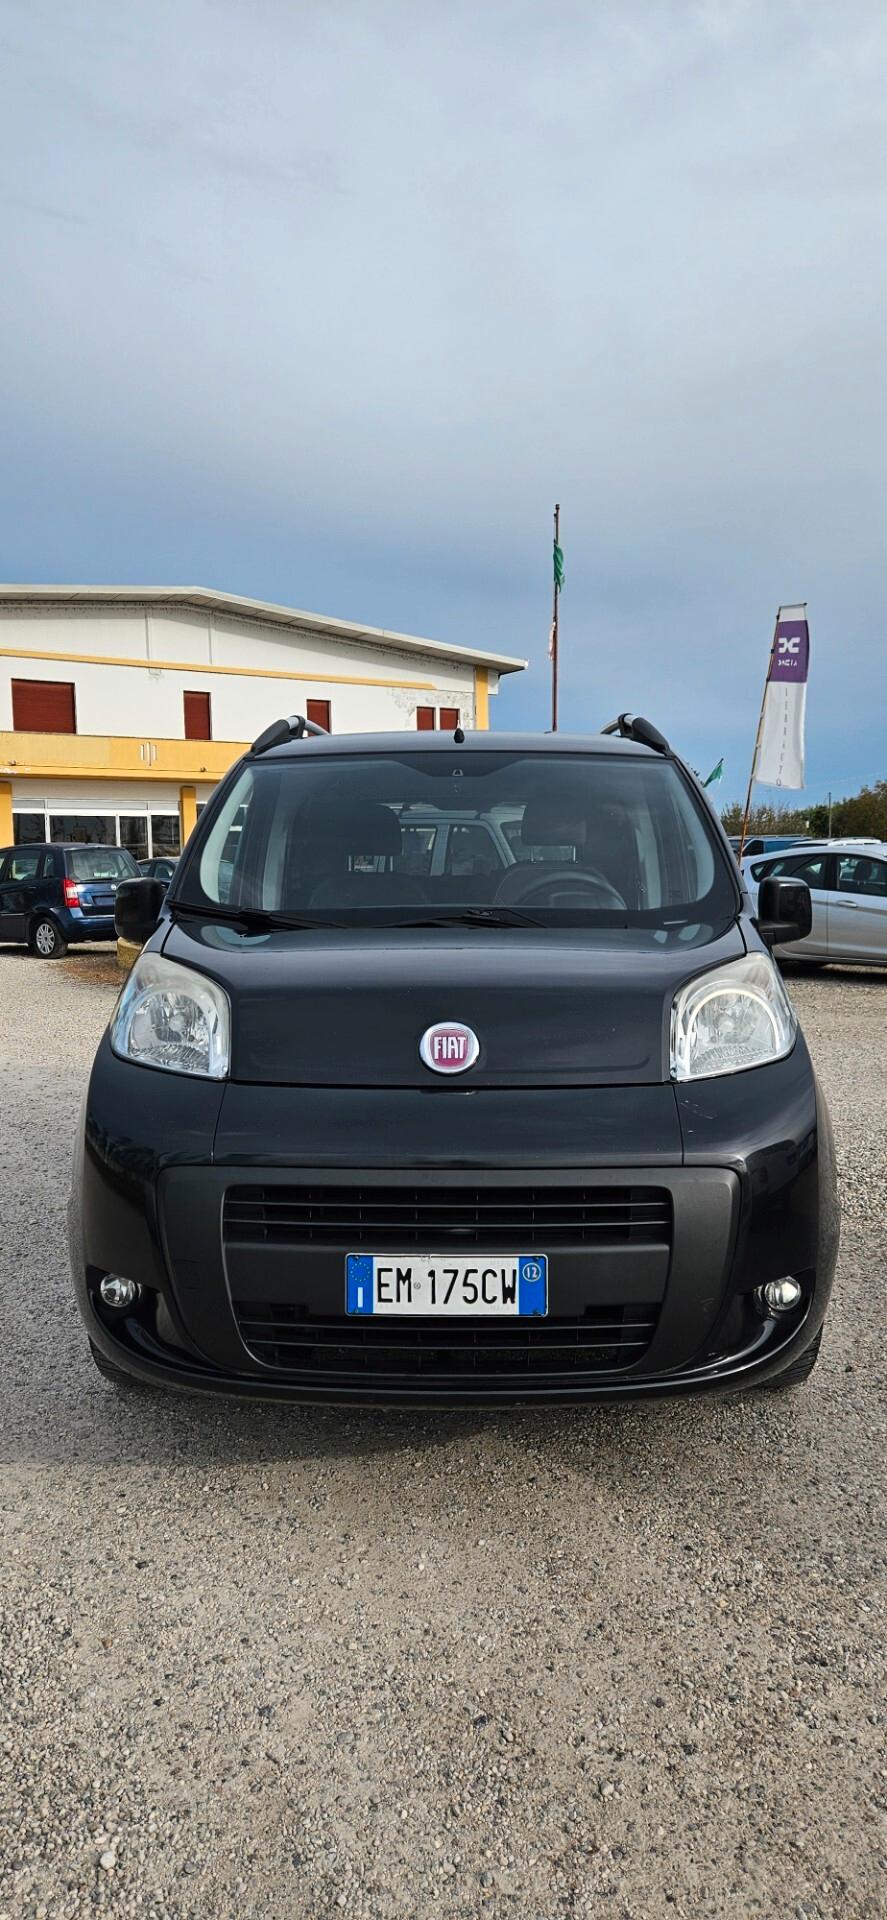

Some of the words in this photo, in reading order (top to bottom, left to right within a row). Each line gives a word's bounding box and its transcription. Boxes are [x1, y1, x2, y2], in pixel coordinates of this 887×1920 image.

[433, 1036, 467, 1060] FIAT
[376, 1267, 413, 1303] EM
[427, 1268, 518, 1305] 175CW
[526, 1266, 538, 1279] 12
